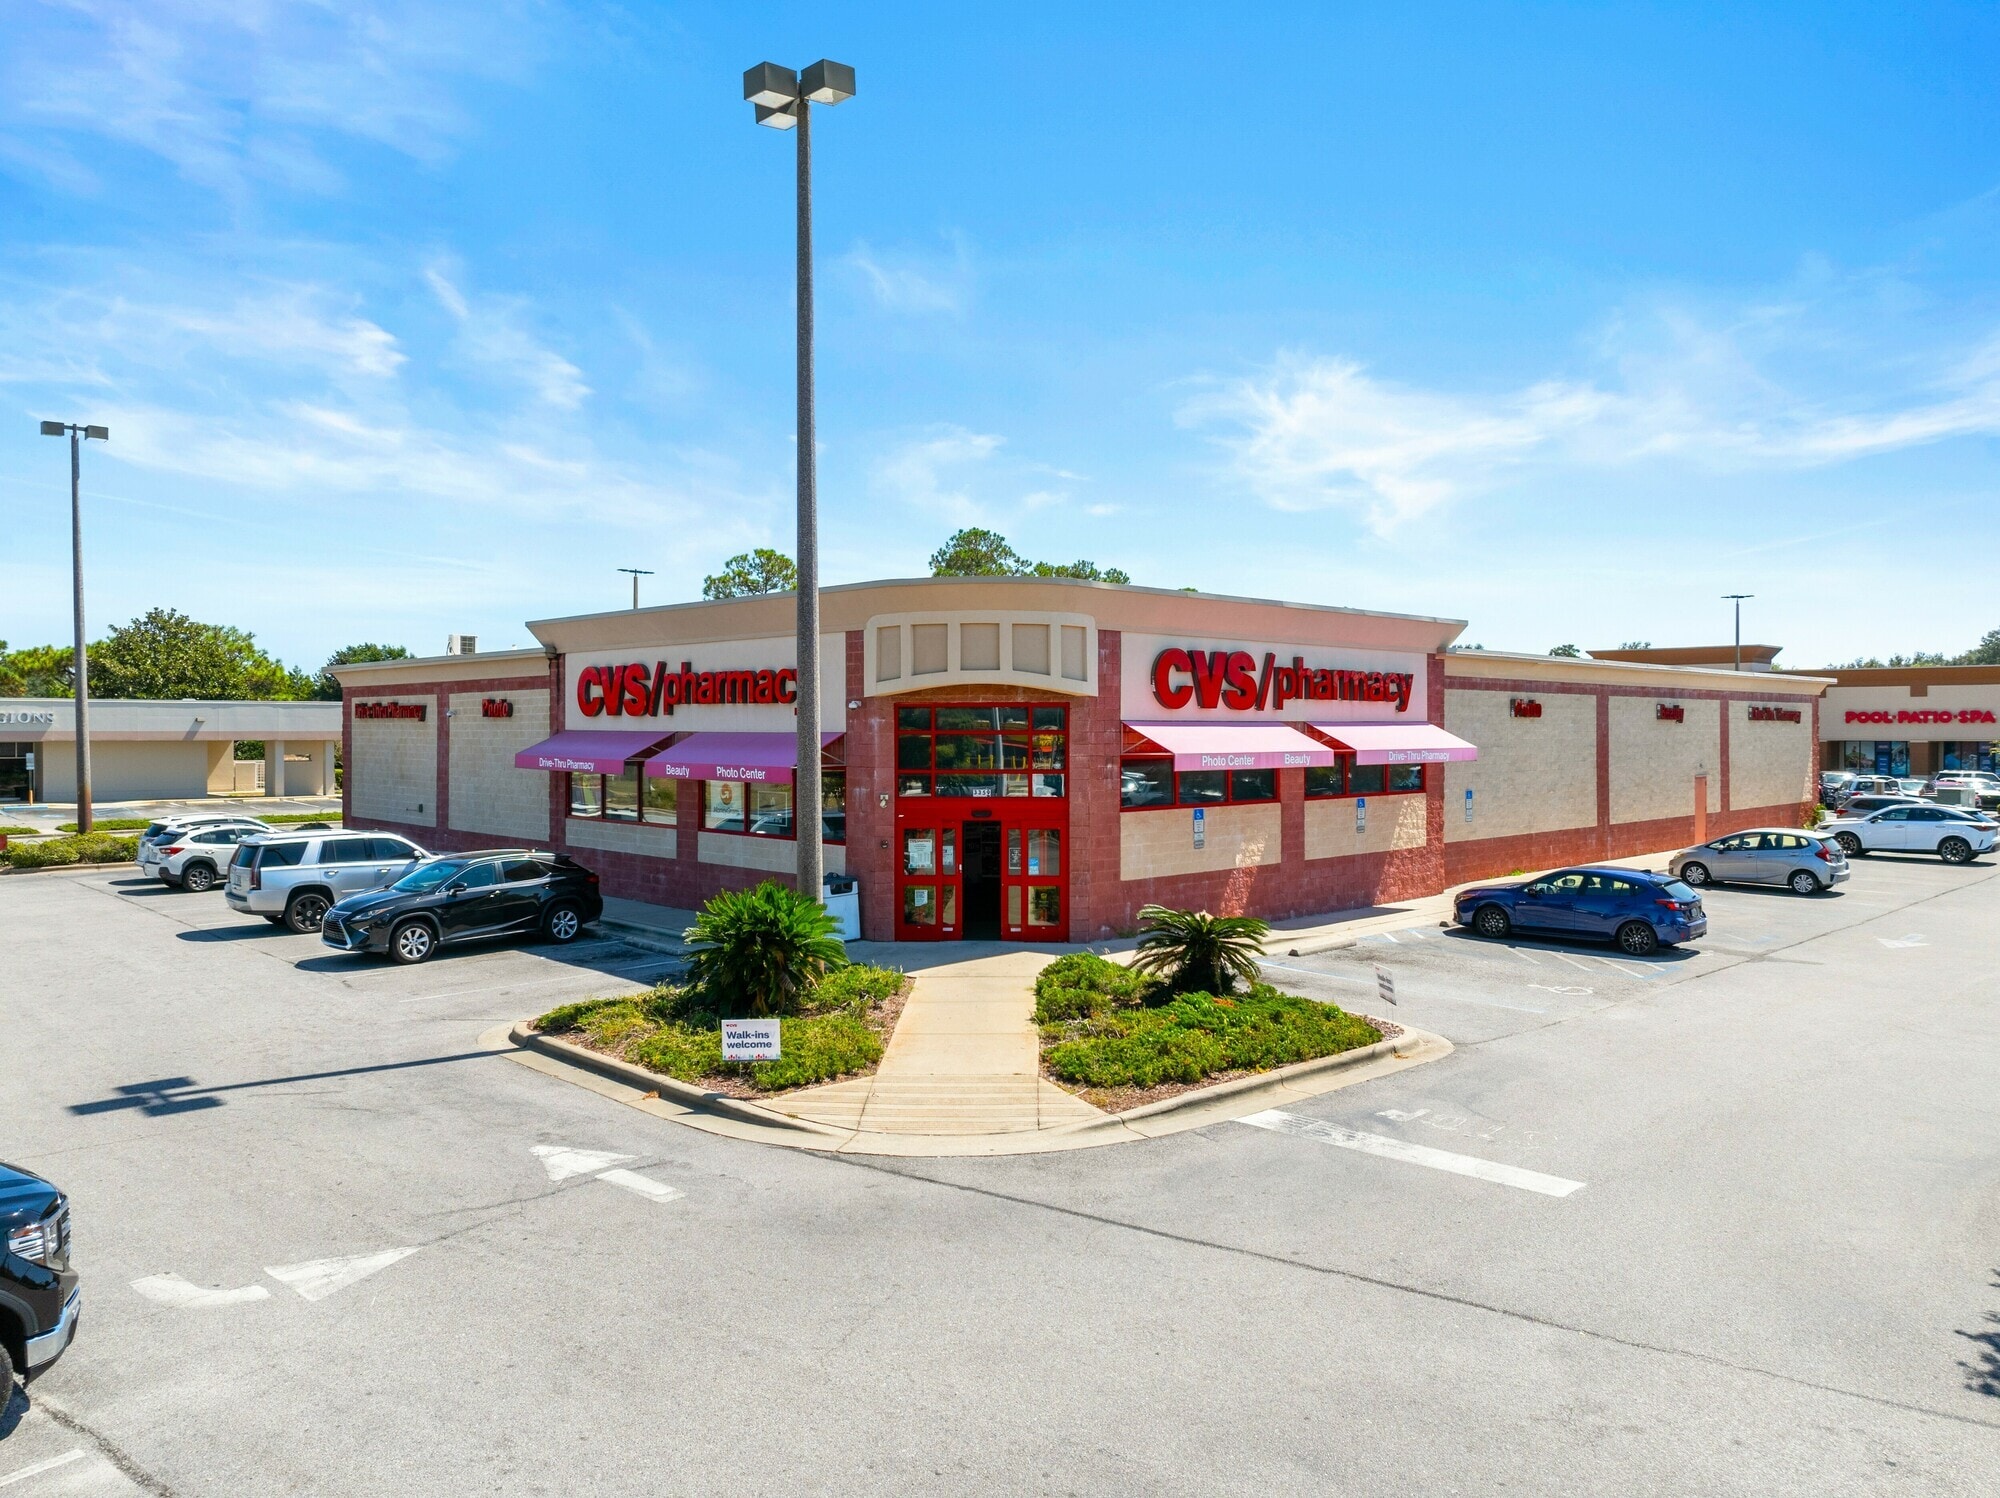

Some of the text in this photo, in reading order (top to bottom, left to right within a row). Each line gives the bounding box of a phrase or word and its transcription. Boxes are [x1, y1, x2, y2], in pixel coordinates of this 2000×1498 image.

[1151, 648, 1414, 712] CVS/pharmacy
[577, 661, 797, 717] CVS/pharmac
[1201, 753, 1311, 767] Photo Center Beauty
[1388, 750, 1450, 762] Drive-Thru Pharmacy
[539, 757, 595, 772] Drive-Thru Pharmacy
[666, 764, 766, 780] Beauty Photo Center
[726, 1030, 770, 1039] Walk-ins
[726, 1040, 773, 1049] welcome
